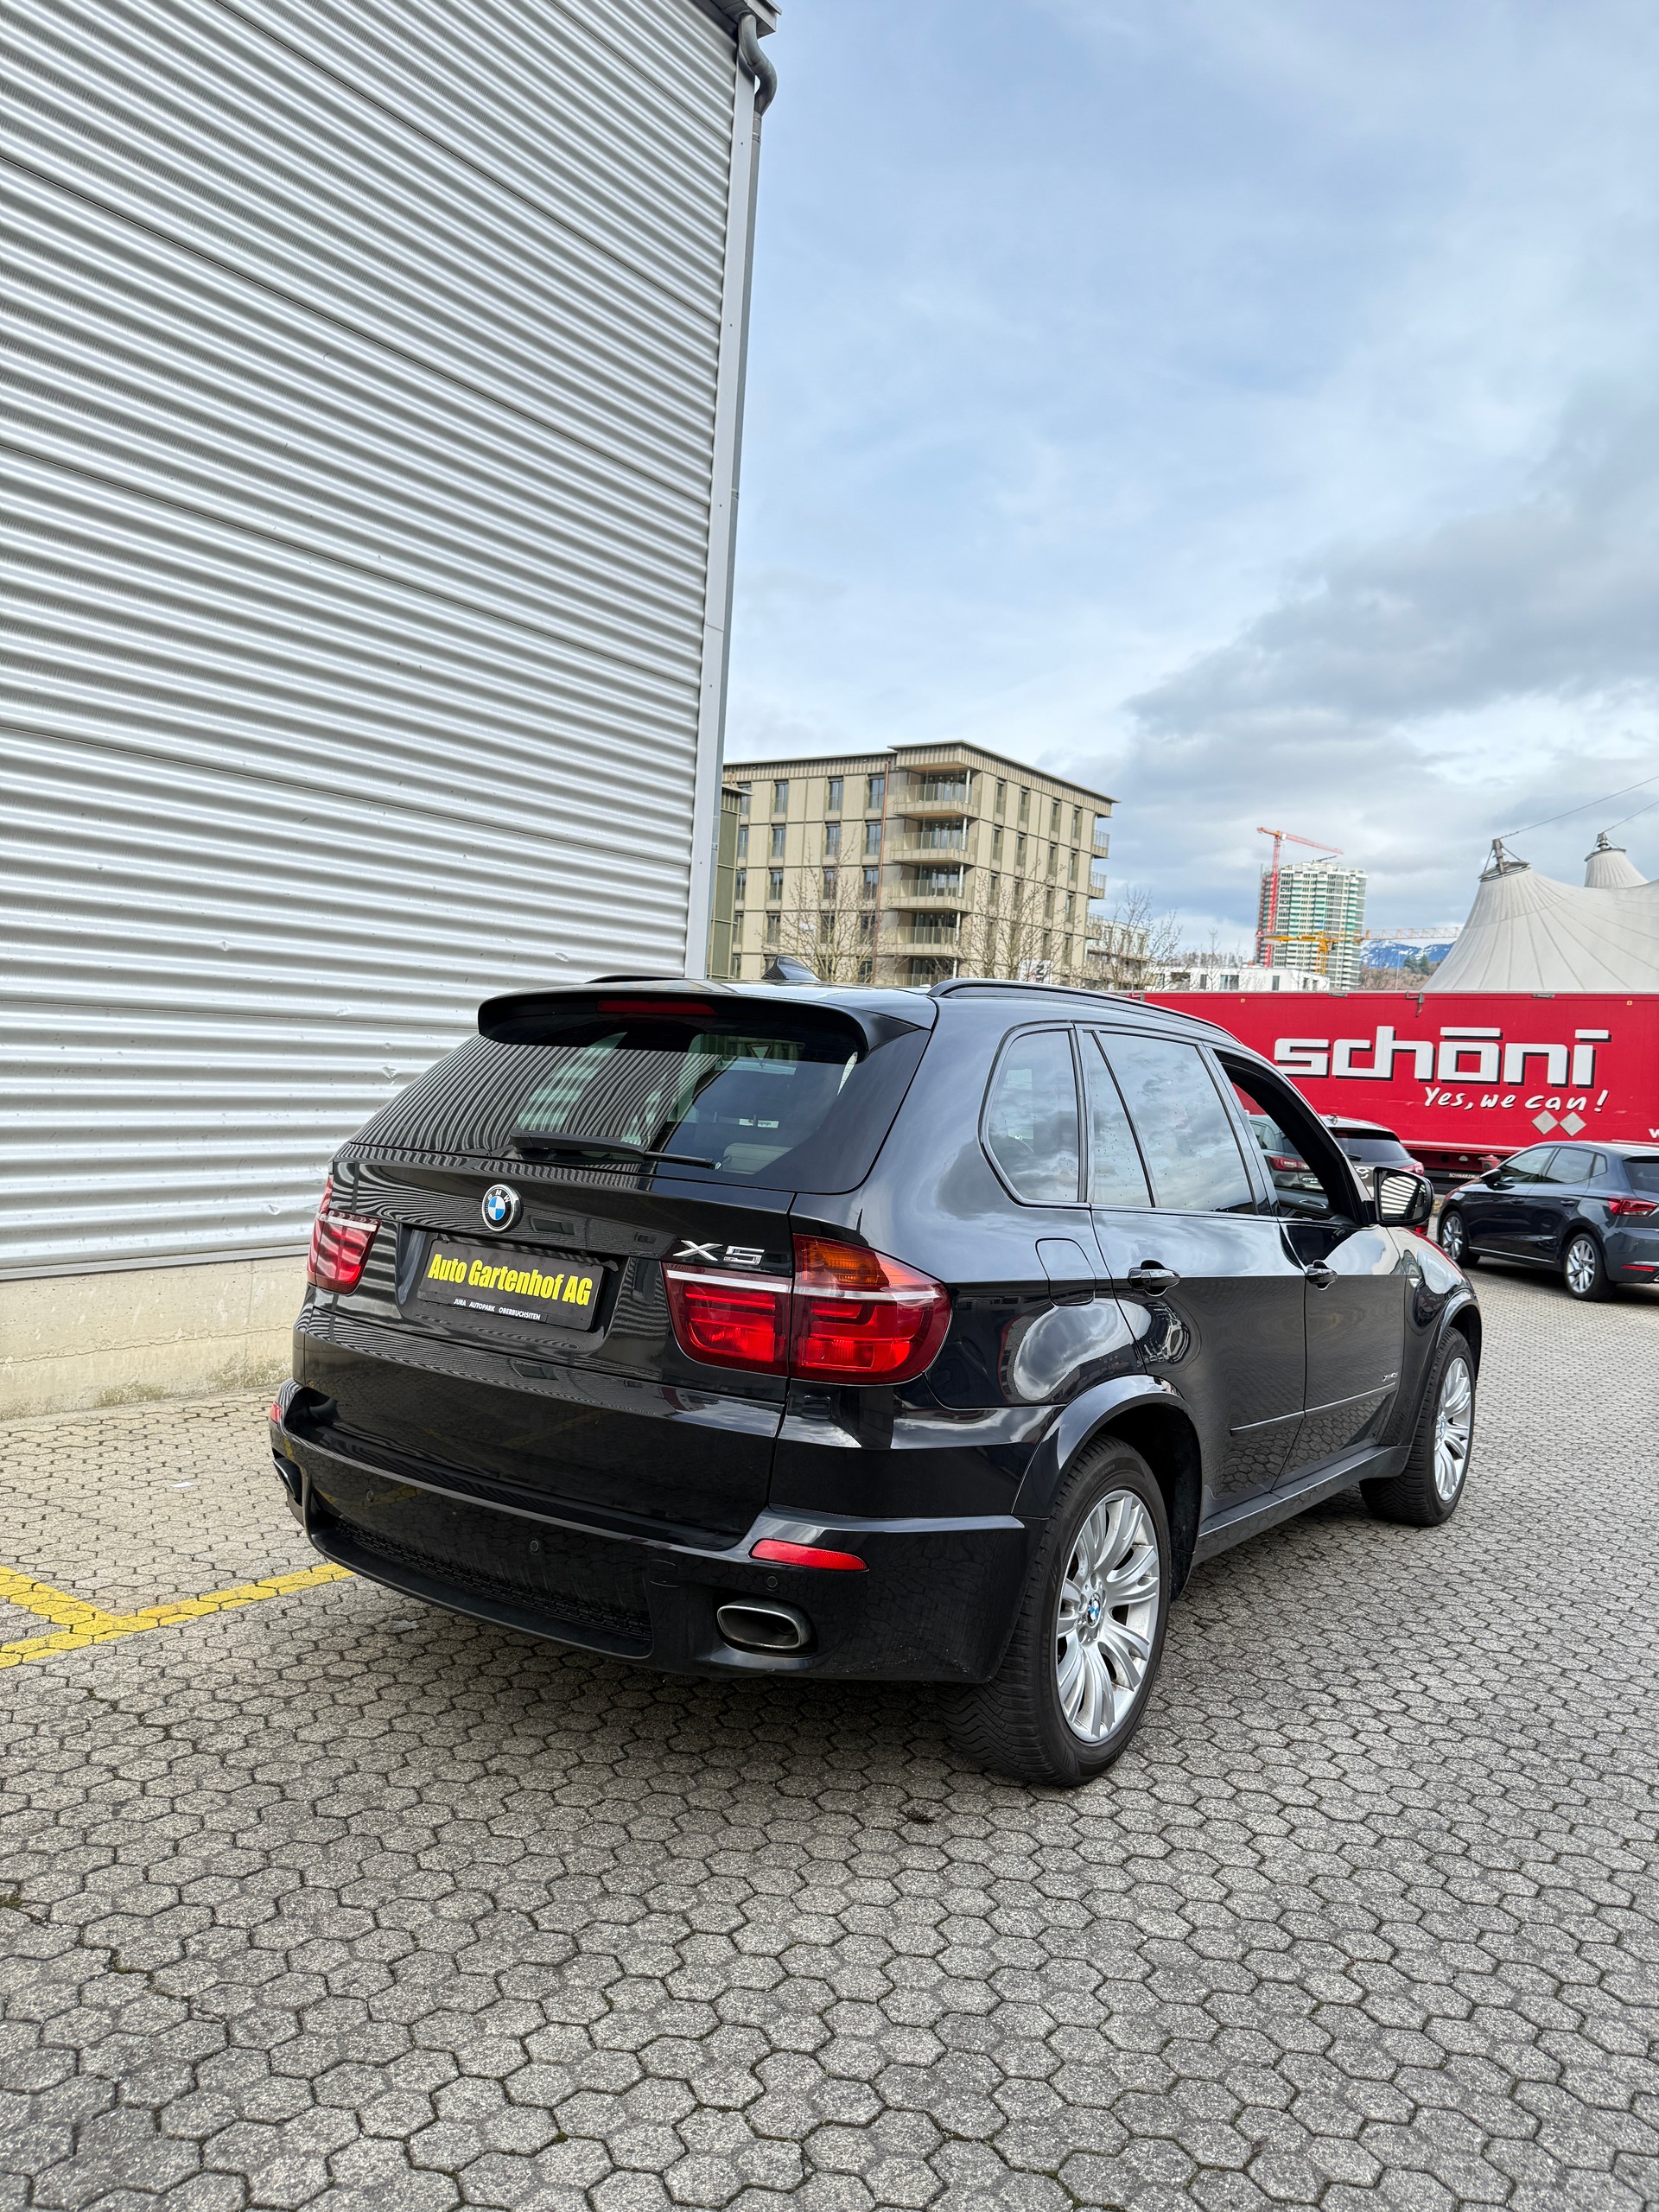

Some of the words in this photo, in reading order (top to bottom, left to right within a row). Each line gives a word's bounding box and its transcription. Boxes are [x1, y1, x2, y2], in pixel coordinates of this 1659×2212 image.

[1425, 1086, 1474, 1110] Yes,
[1480, 1094, 1516, 1109] we
[487, 1189, 512, 1203] BMW
[672, 1239, 765, 1266] X5
[428, 1253, 467, 1284] Auto
[467, 1259, 565, 1300] Gartenhof
[562, 1274, 593, 1306] AG
[454, 1298, 467, 1306] JURA
[468, 1301, 496, 1313] AUTOPARK
[498, 1306, 541, 1321] OBERBUCHSITEN
